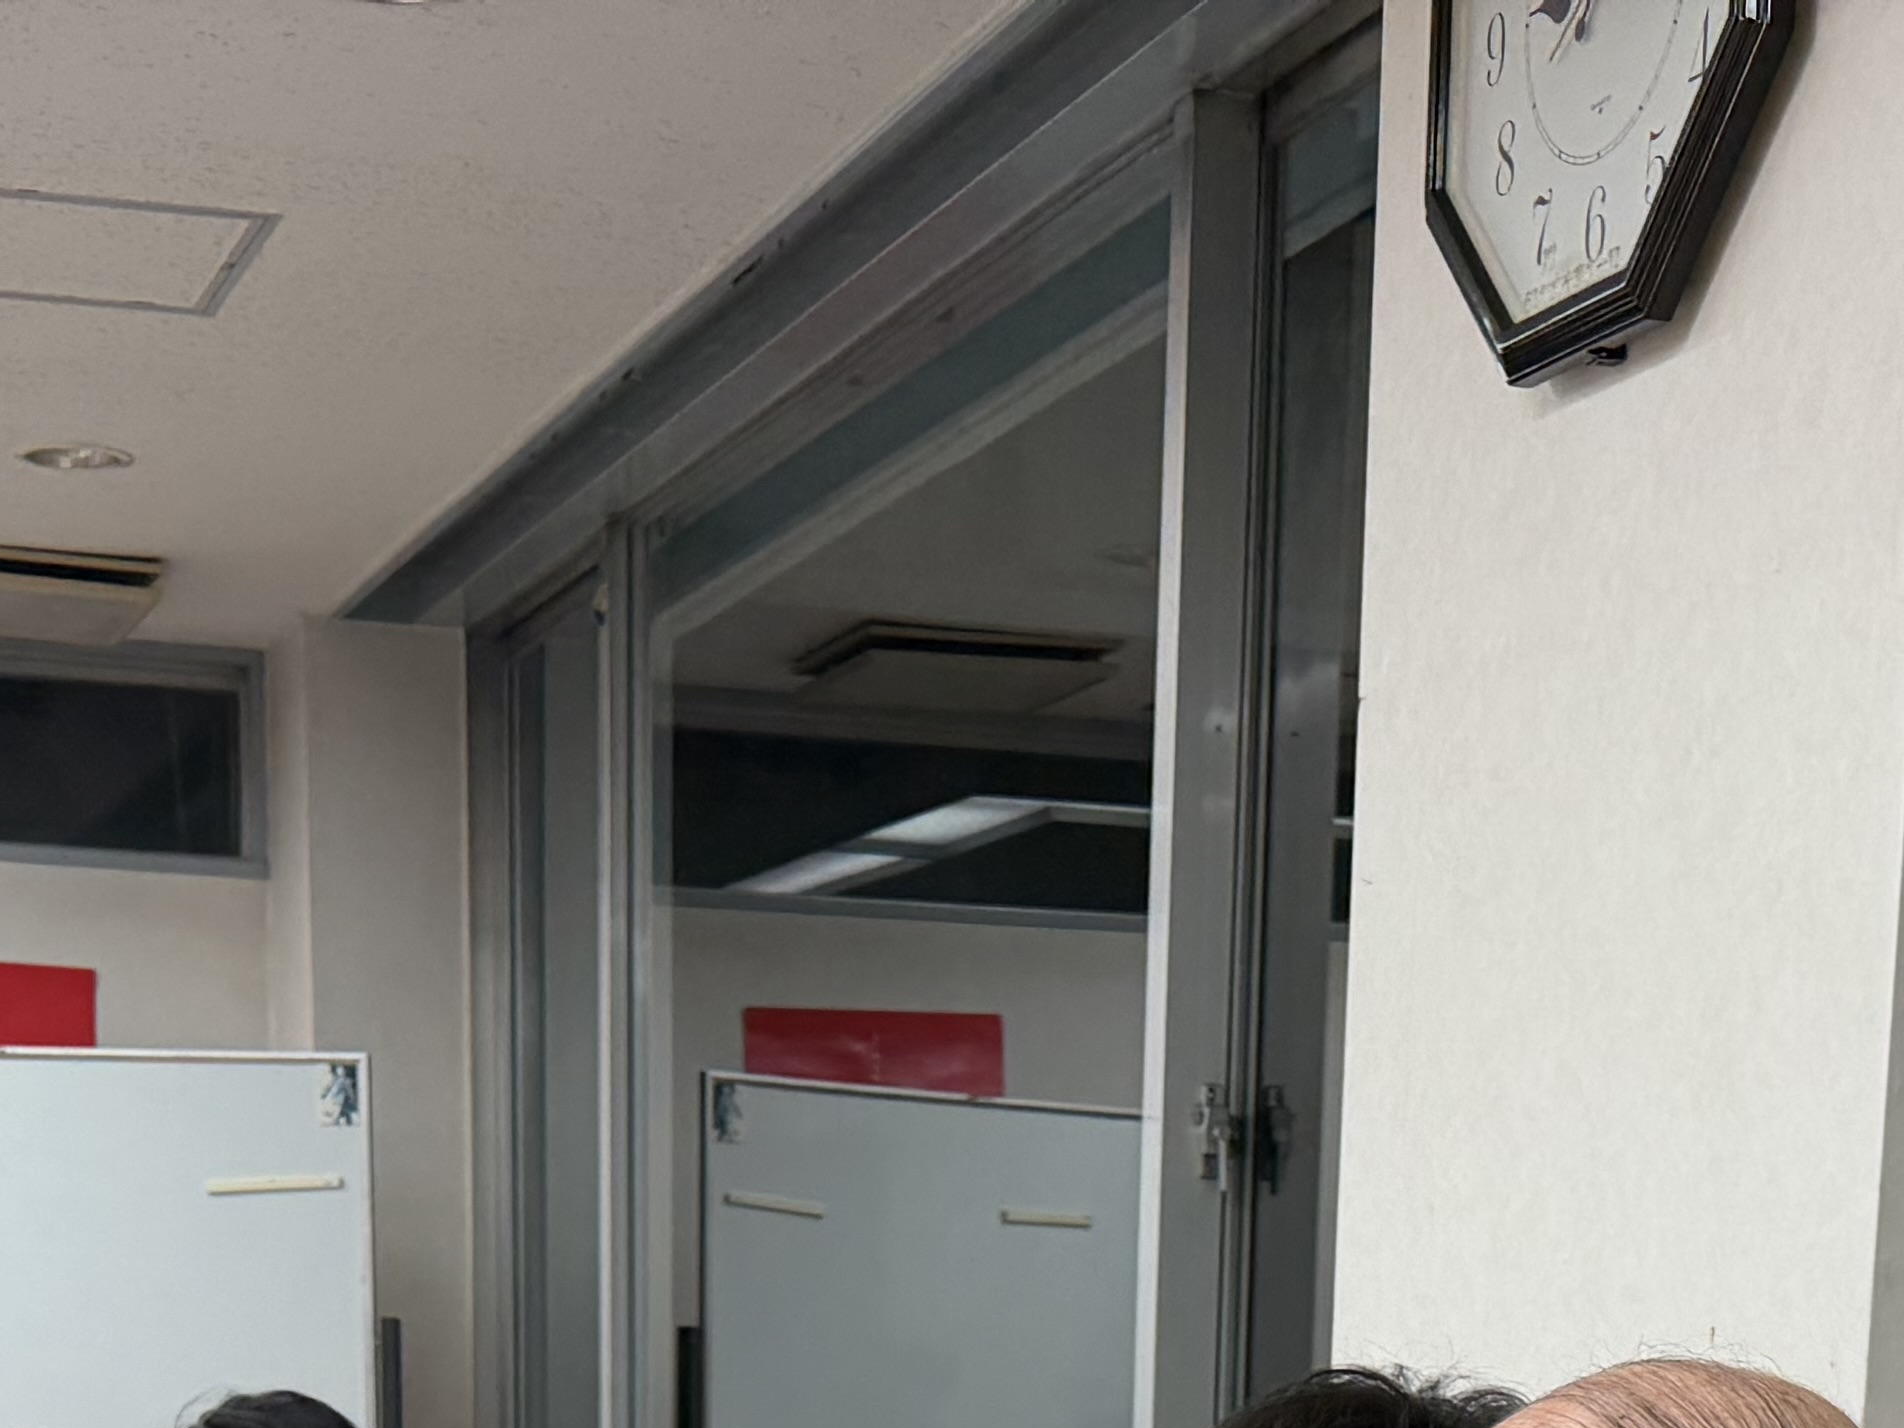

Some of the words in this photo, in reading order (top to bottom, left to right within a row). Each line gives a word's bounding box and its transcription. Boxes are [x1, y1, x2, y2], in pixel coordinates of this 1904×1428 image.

[1487, 12, 1506, 88] 9
[1688, 8, 1710, 83] 4
[1495, 120, 1516, 197] 8
[1644, 125, 1667, 205] 5
[1533, 188, 1553, 266] 7
[1585, 185, 1607, 263] 6
